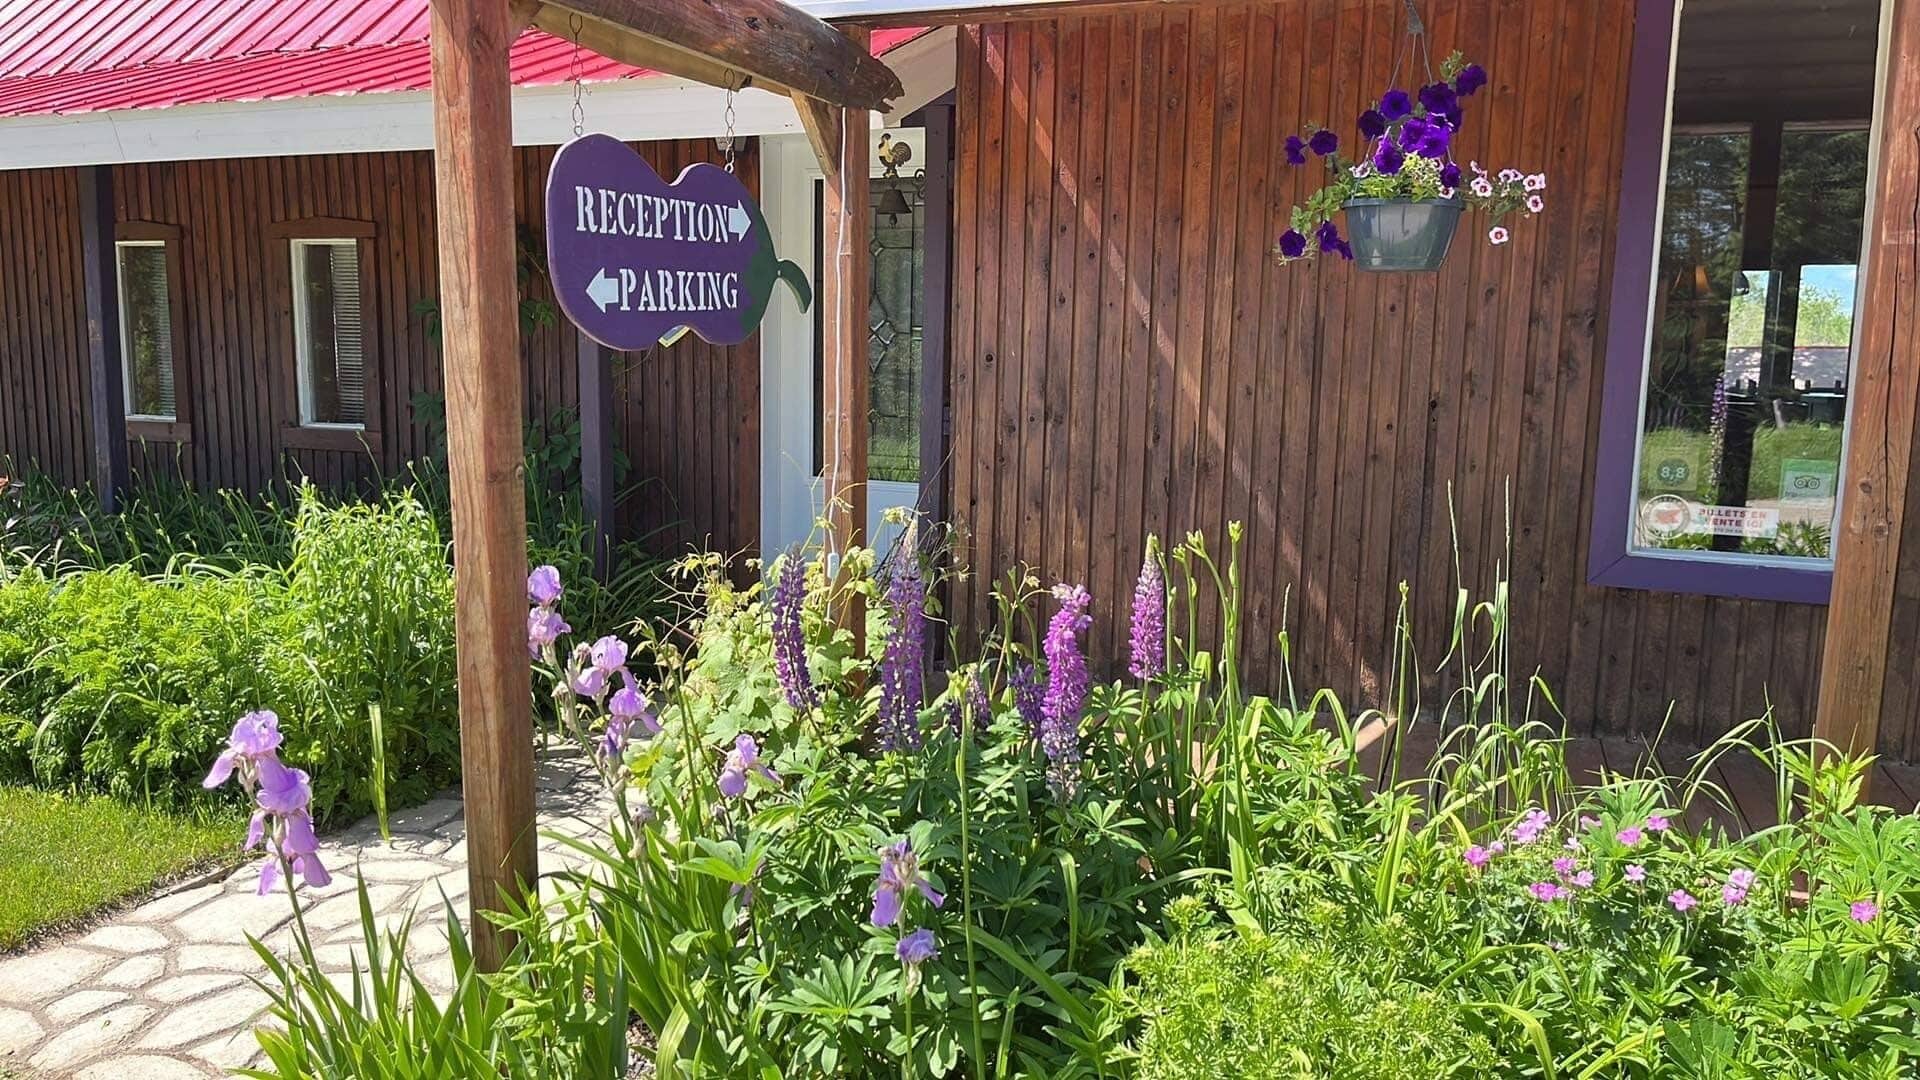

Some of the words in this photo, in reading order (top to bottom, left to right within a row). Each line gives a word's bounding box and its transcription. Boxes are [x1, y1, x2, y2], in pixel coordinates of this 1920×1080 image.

[575, 185, 729, 243] RECEPTION
[619, 268, 738, 311] PARKING
[1660, 466, 1685, 480] 8,8
